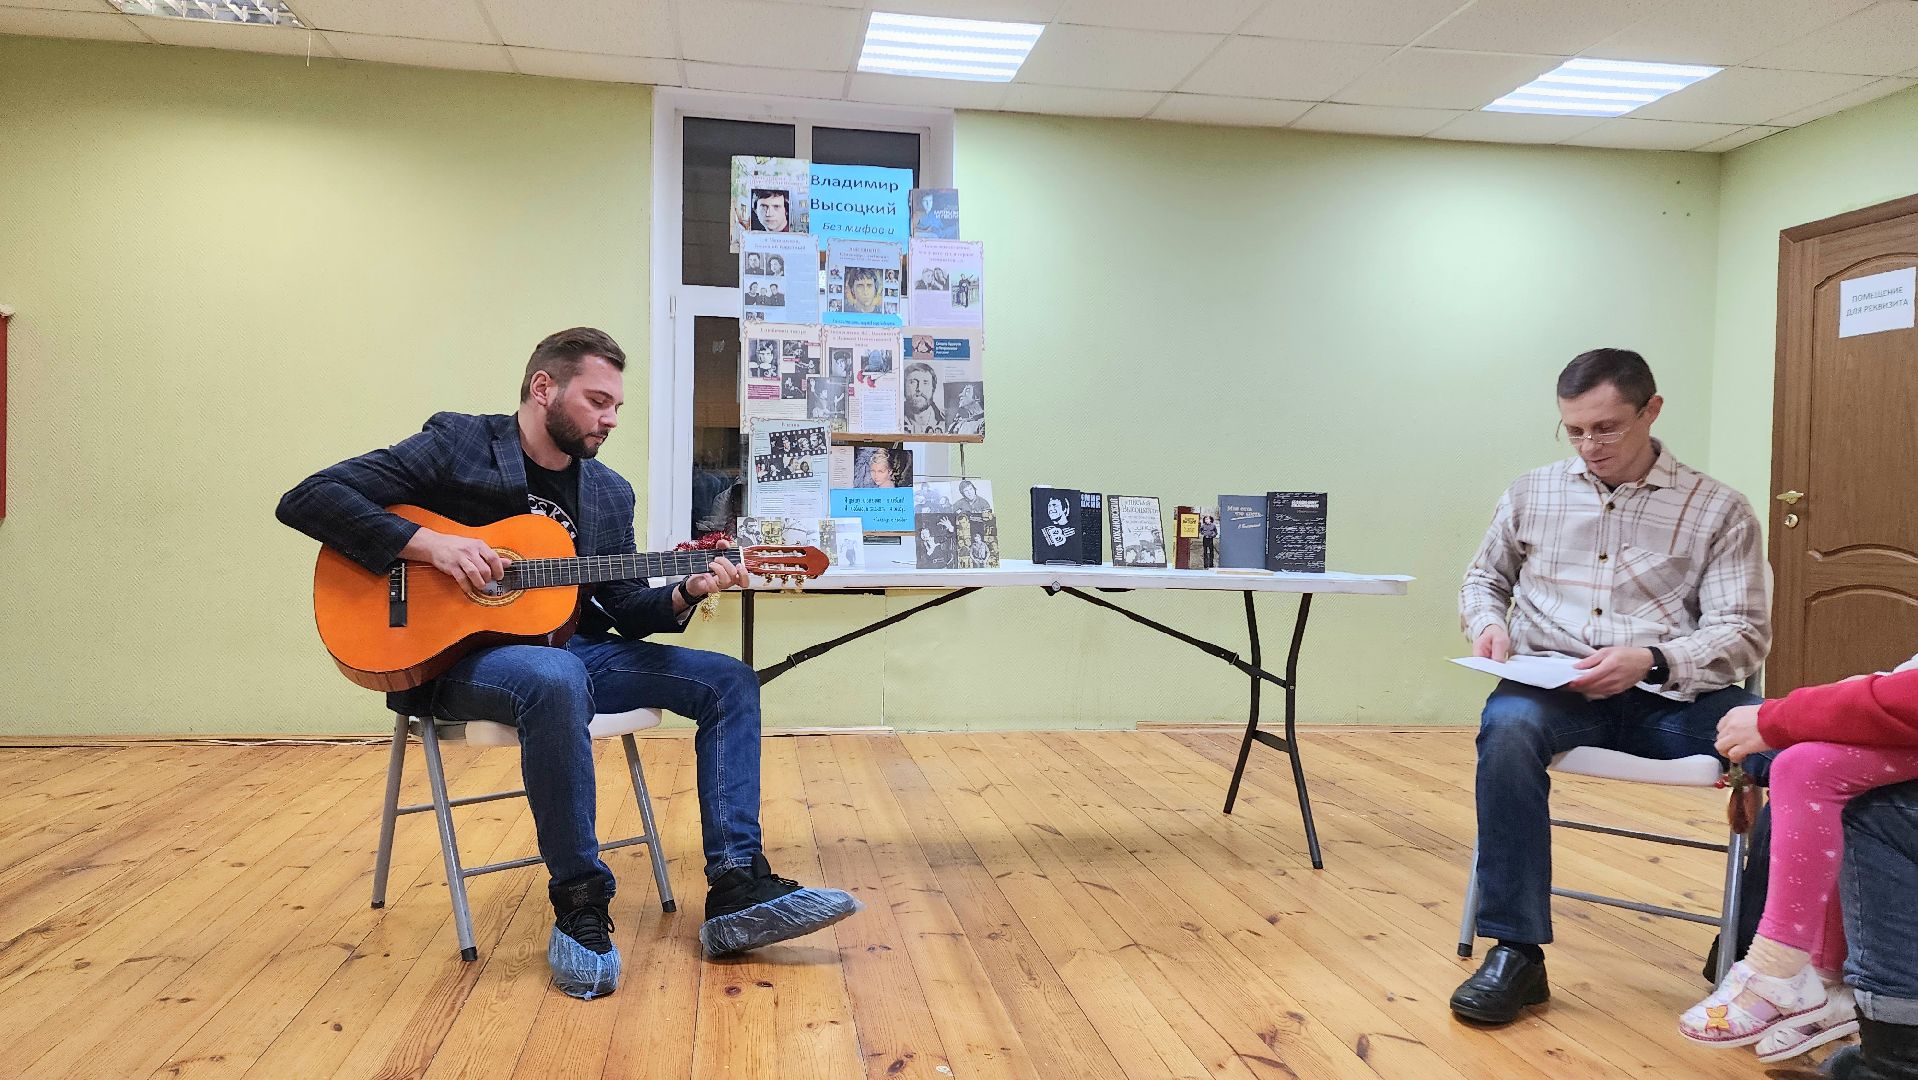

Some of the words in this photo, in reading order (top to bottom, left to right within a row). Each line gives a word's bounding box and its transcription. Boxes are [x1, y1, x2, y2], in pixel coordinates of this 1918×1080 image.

[811, 174, 899, 193] Владимир
[810, 198, 896, 216] Высоцкий
[822, 222, 842, 231] Без
[844, 224, 885, 235] мифов
[887, 227, 896, 235] и
[1852, 286, 1904, 303] ПОМЕЩЕНИЕ
[1845, 306, 1863, 317] ДЛЯ
[1863, 298, 1909, 313] РЕКВИЗИТА
